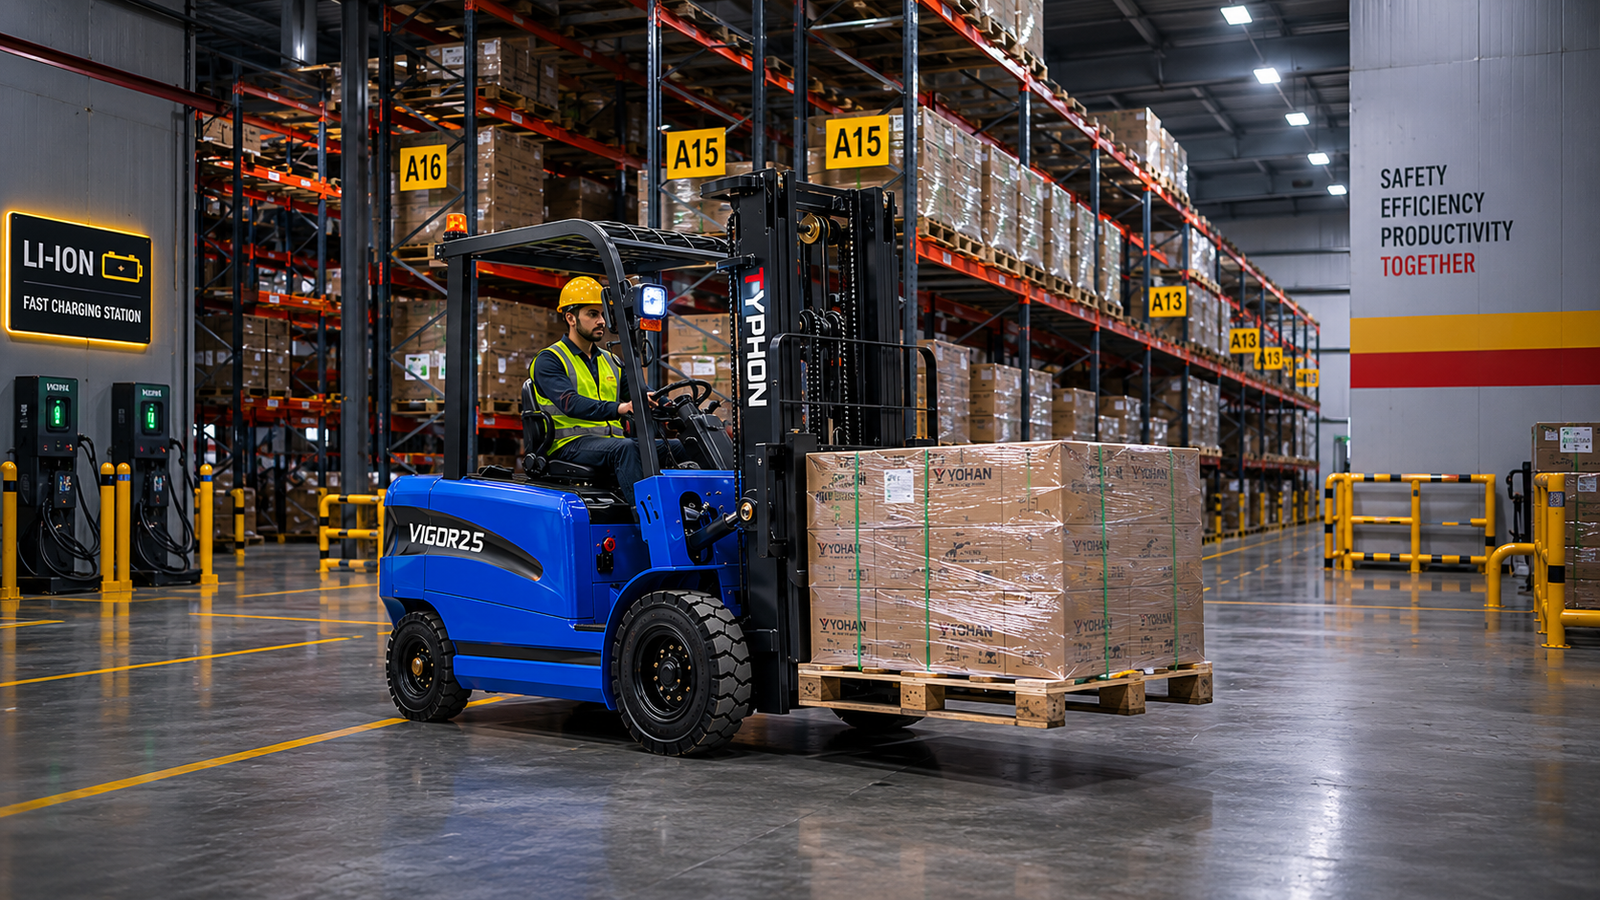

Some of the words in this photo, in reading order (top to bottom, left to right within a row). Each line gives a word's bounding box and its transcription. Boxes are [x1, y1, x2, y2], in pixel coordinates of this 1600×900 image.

[673, 137, 718, 169] A15
[833, 125, 881, 159] A15
[405, 153, 441, 182] A16
[1380, 164, 1447, 189] SAFETY
[1381, 192, 1485, 218] EFFICIENCY
[1381, 220, 1513, 247] PRODUCTIVITY
[23, 239, 94, 276] LI-ION
[1380, 252, 1475, 277] TOGETHER
[23, 295, 49, 311] FAST
[51, 299, 101, 319] CHARGING
[104, 306, 141, 323] STATION
[1152, 292, 1182, 311] A13
[745, 267, 767, 407] TYPHON
[1231, 332, 1256, 348] A13
[947, 467, 992, 482] YOHAN
[409, 523, 485, 553] VIGOR25
[830, 618, 867, 632] YOHAN
